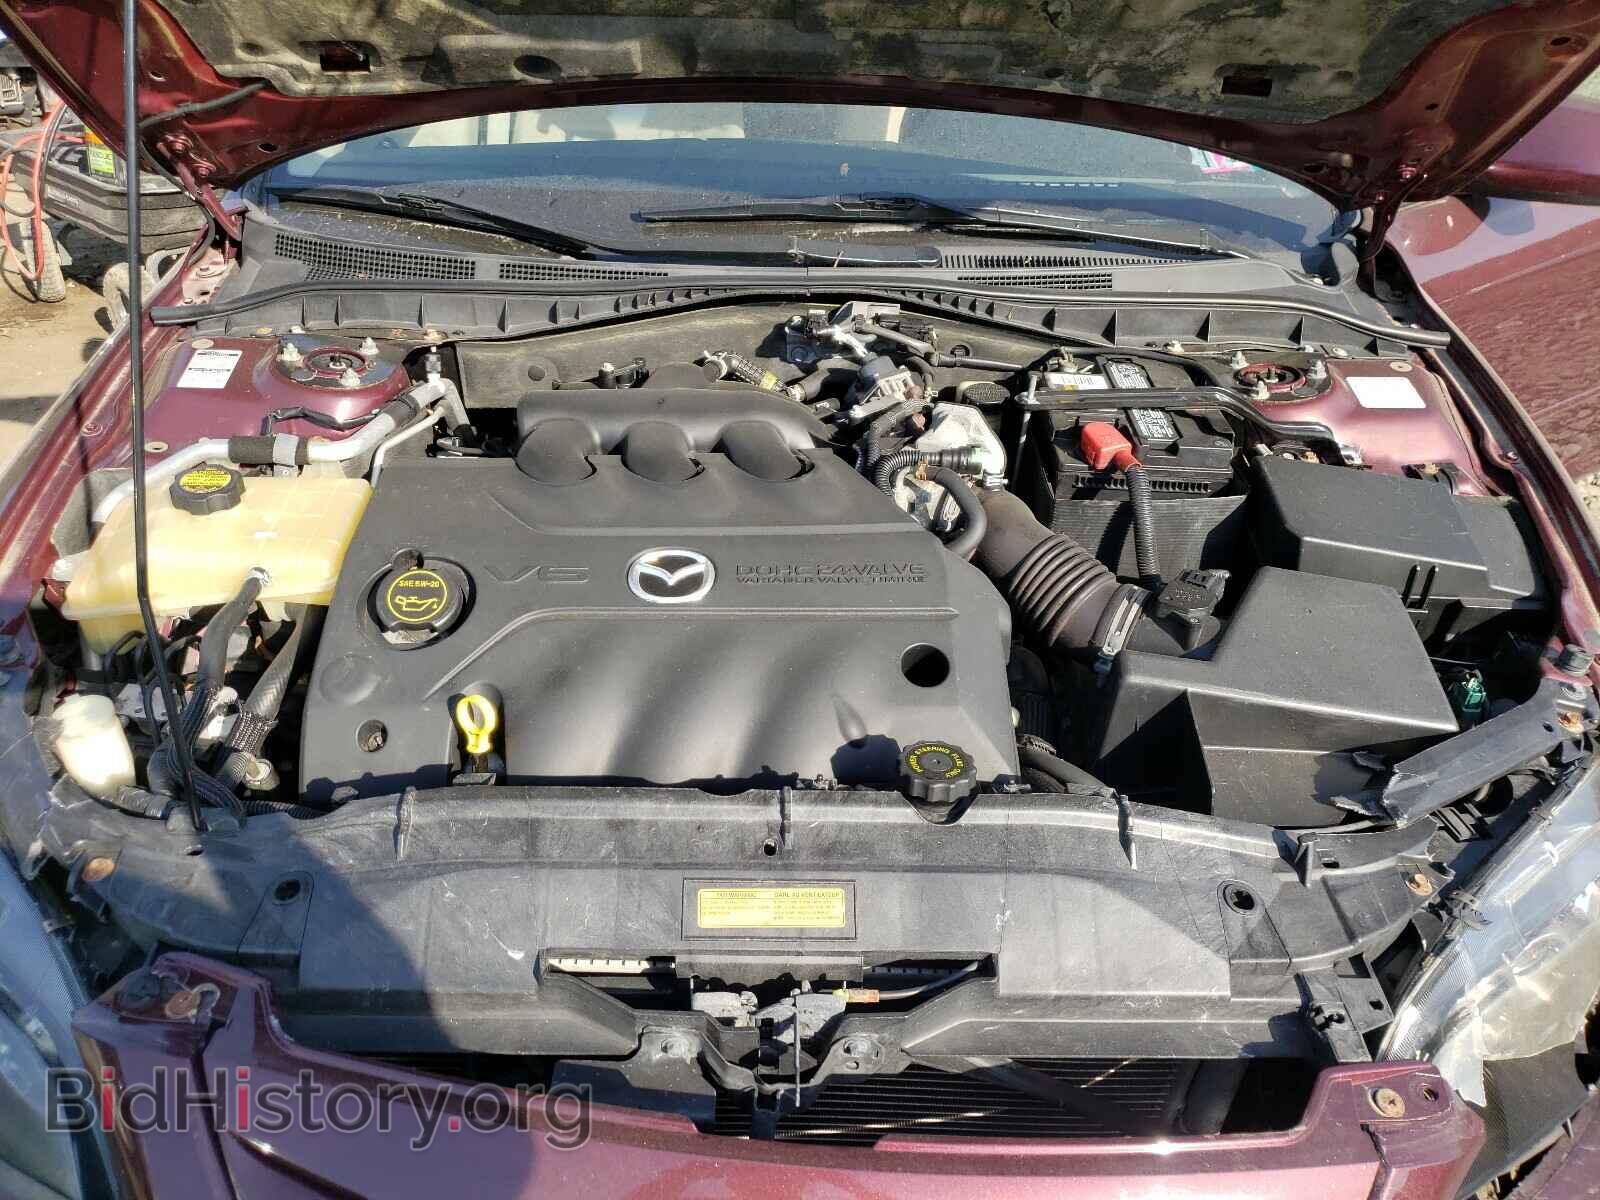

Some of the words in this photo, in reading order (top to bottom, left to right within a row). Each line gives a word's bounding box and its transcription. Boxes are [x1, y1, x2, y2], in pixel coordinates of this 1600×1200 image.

[484, 565, 589, 584] V6
[736, 561, 815, 576] DOHC
[398, 578, 414, 588] SAE
